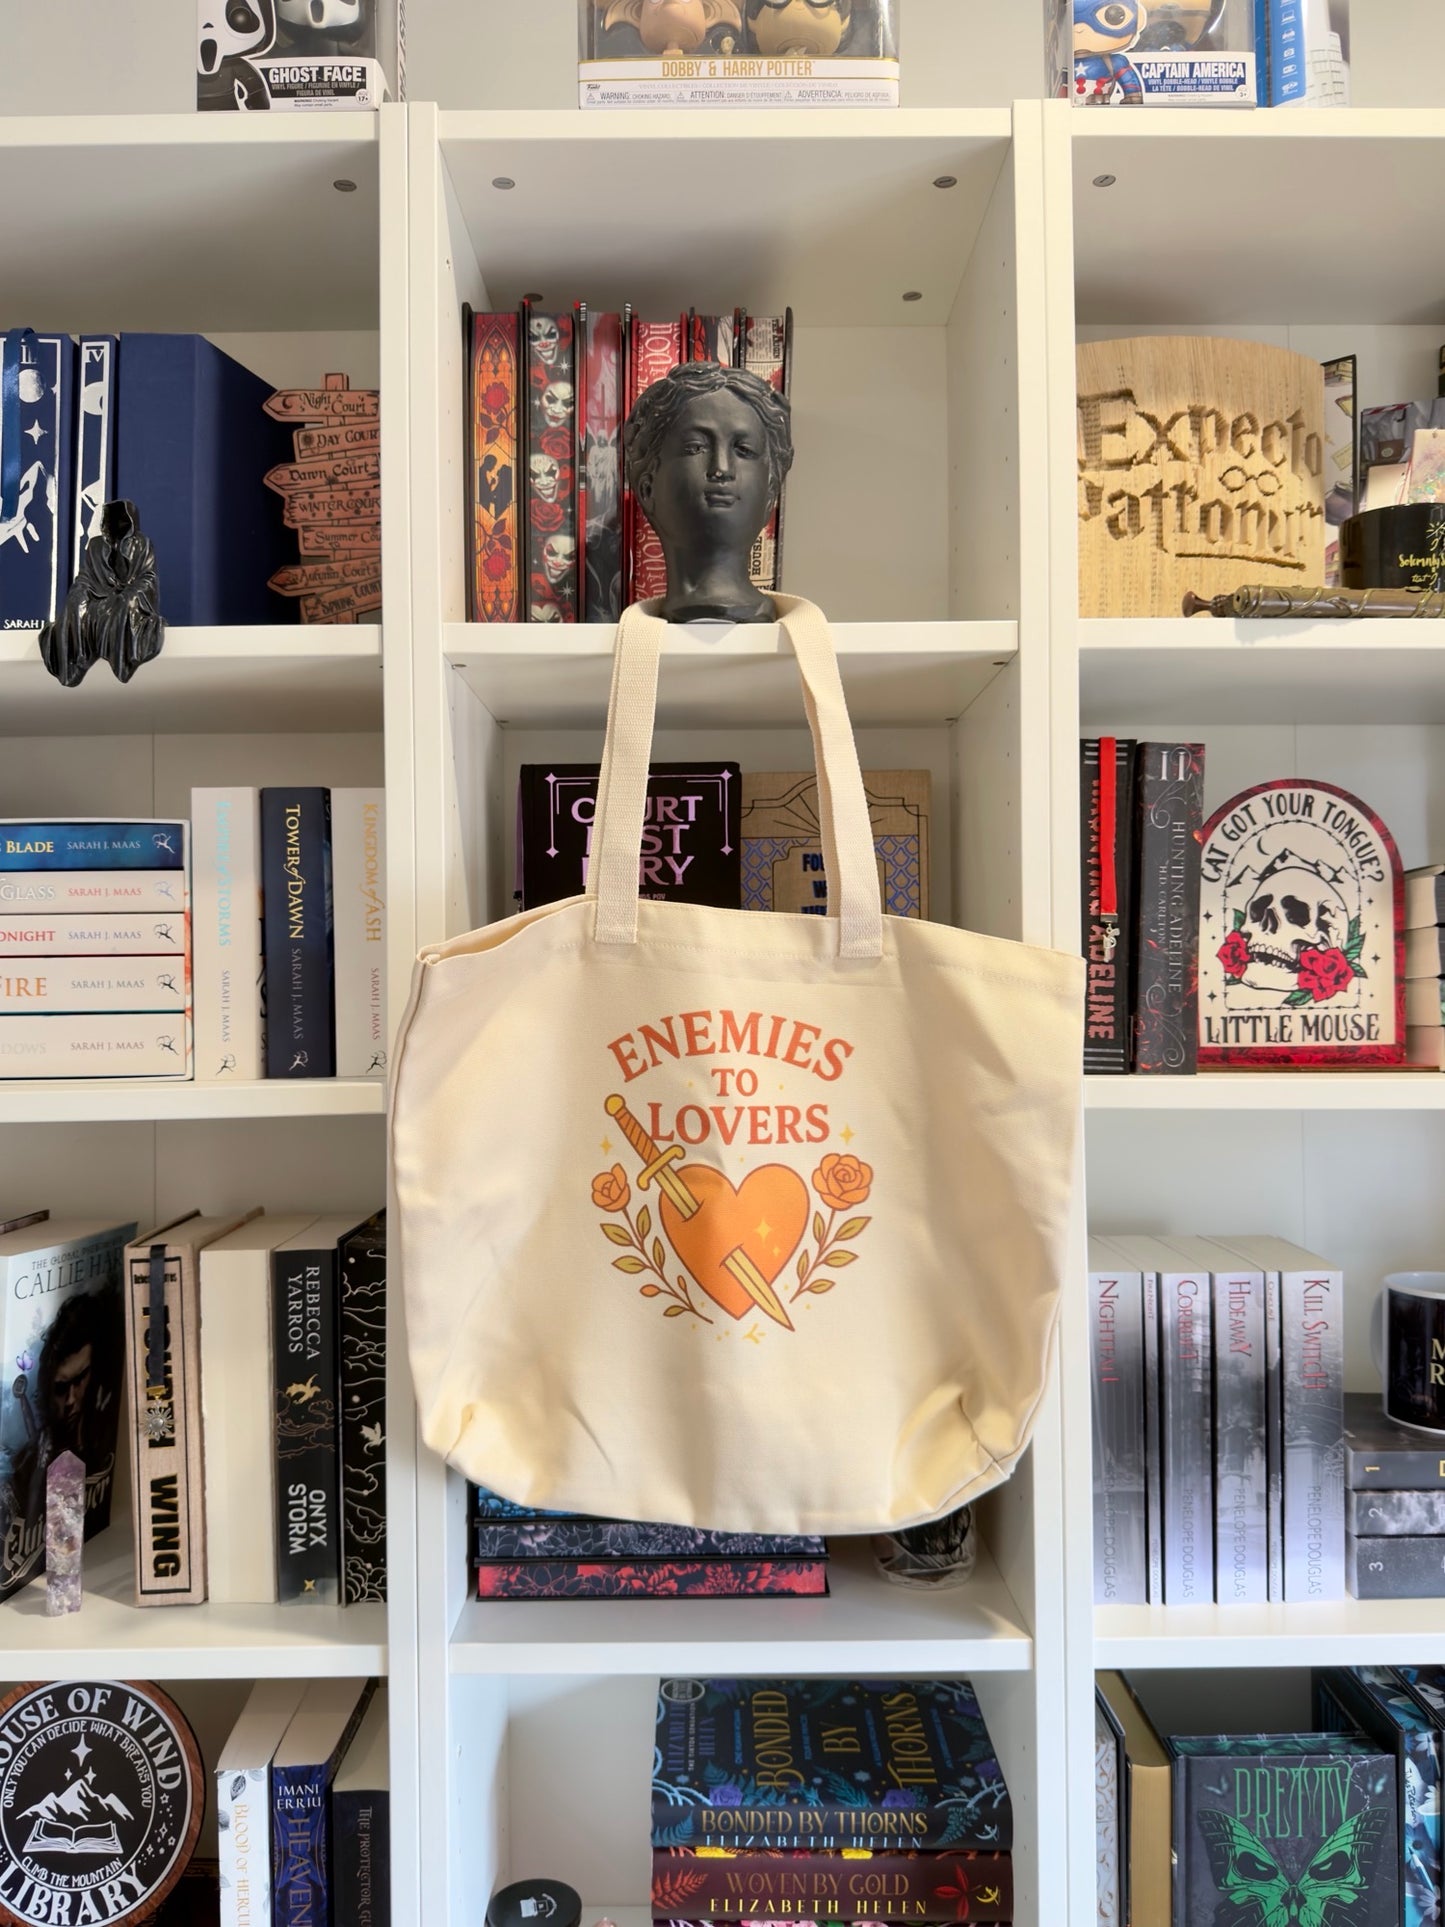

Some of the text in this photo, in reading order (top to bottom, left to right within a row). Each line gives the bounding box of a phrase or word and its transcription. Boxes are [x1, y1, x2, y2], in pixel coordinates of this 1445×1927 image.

[269, 66, 362, 84] GHOST FACE
[662, 60, 812, 77] DOBBY & HARRY POTTER
[1142, 62, 1244, 78] CAPTAIN AMERICA
[331, 400, 366, 415] Court
[344, 428, 380, 444] COUR
[332, 461, 370, 476] Court
[346, 498, 381, 511] COUR
[361, 531, 380, 544] Cou
[3, 619, 39, 630] SARAH
[571, 796, 703, 824] CRT
[6, 840, 141, 853] BLADE SARAH J. MAAS
[285, 804, 302, 868] TOWER
[363, 803, 381, 886] KINGDOM
[1201, 792, 1385, 884] CAT GOT YOUR TONGUE?
[0, 884, 142, 901] GLASS SARAH J. MAAS
[287, 881, 304, 939] DAWN
[1168, 821, 1186, 993] HUNTING ADELINE
[218, 878, 231, 947] STORMS
[366, 904, 381, 943] ASH
[1158, 891, 1167, 945] CARLTON
[0, 930, 142, 943] DNIGHT SARAH J. MAAS
[0, 976, 145, 997] IRE SARAH J. MAAS
[221, 970, 231, 1004] SARAH
[291, 948, 302, 992] SARAH
[370, 967, 380, 1002] SARAH
[221, 1014, 231, 1043] MAAS
[291, 1004, 304, 1040] MAAS
[371, 1011, 381, 1040] MAAS
[1205, 1013, 1380, 1044] LITTLE MOUSE
[71, 1041, 145, 1051] SARAH J. MAAS
[607, 1009, 855, 1083] ENEMIES
[711, 1068, 758, 1097] TO
[647, 1102, 830, 1146] LOVERS
[14, 1260, 84, 1300] CALLIE
[32, 1259, 48, 1271] THE
[288, 1274, 303, 1354] YARROS
[306, 1265, 321, 1361] REBECCA
[1228, 1281, 1252, 1357] HIDEAWAY
[1300, 1279, 1330, 1389] KILL SWITCH
[151, 1473, 181, 1579] WING
[288, 1483, 307, 1555] STORM
[309, 1488, 328, 1548] ONYX
[1368, 1507, 1383, 1518] 2
[1182, 1488, 1194, 1598] PENELOPE DOUGLAS
[1233, 1488, 1246, 1597] PENELOPE DOUGLAS
[1307, 1486, 1322, 1594] PENELOPE DOUGLAS
[1104, 1537, 1116, 1599] DOUGLAS
[1369, 1561, 1384, 1571] 3
[0, 1687, 182, 1790] OUSE OF WIND
[752, 1690, 805, 1791] BONDED
[820, 1721, 861, 1752] BY
[881, 1692, 938, 1790] THORNS
[4, 1720, 152, 1808] ONLY YOU CAN DECIDE WHAT BREAKS YOU
[276, 1796, 321, 1810] ERRIU
[279, 1784, 320, 1796] IMANI
[1233, 1764, 1352, 1839] PRETTY
[702, 1809, 928, 1834] BONDED BY THORNS
[706, 1834, 923, 1849] ELIZABETH HELEN
[21, 1855, 123, 1888] CLIMB THE MOUNTAIN
[288, 1817, 313, 1927] HEAVEN
[356, 1834, 373, 1909] PROTECTOR
[725, 1872, 909, 1896] WOVEN BY GOLD
[0, 1862, 148, 1926] LIBRARY
[710, 1898, 927, 1914] ELIZABETH HELEN
